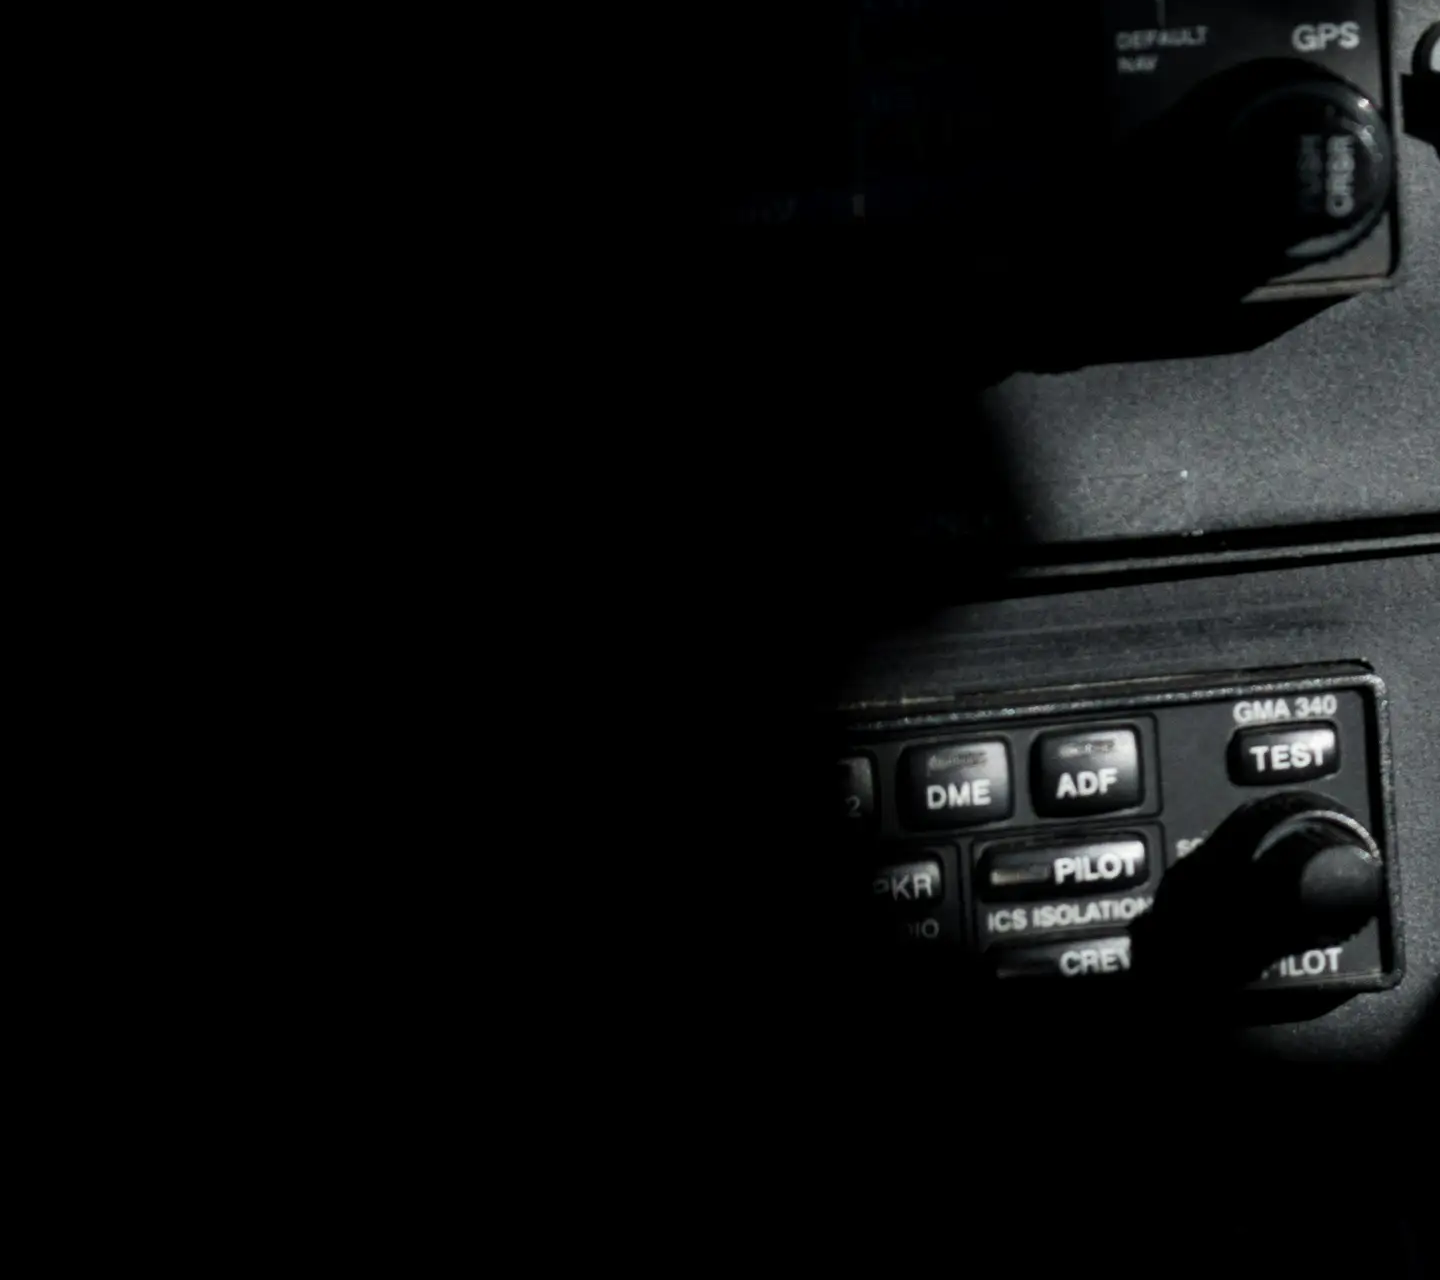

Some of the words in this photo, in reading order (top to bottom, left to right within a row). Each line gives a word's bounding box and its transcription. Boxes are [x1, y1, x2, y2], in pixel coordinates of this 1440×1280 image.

[1292, 21, 1360, 52] GPS
[1233, 696, 1290, 721] GMA
[1297, 693, 1337, 718] 340
[1249, 745, 1326, 772] TEST
[926, 779, 991, 810] DME
[1056, 768, 1117, 799] ADF
[1055, 854, 1138, 886] PILOT
[988, 908, 1027, 932] ICS
[1260, 947, 1343, 980] ILOT
